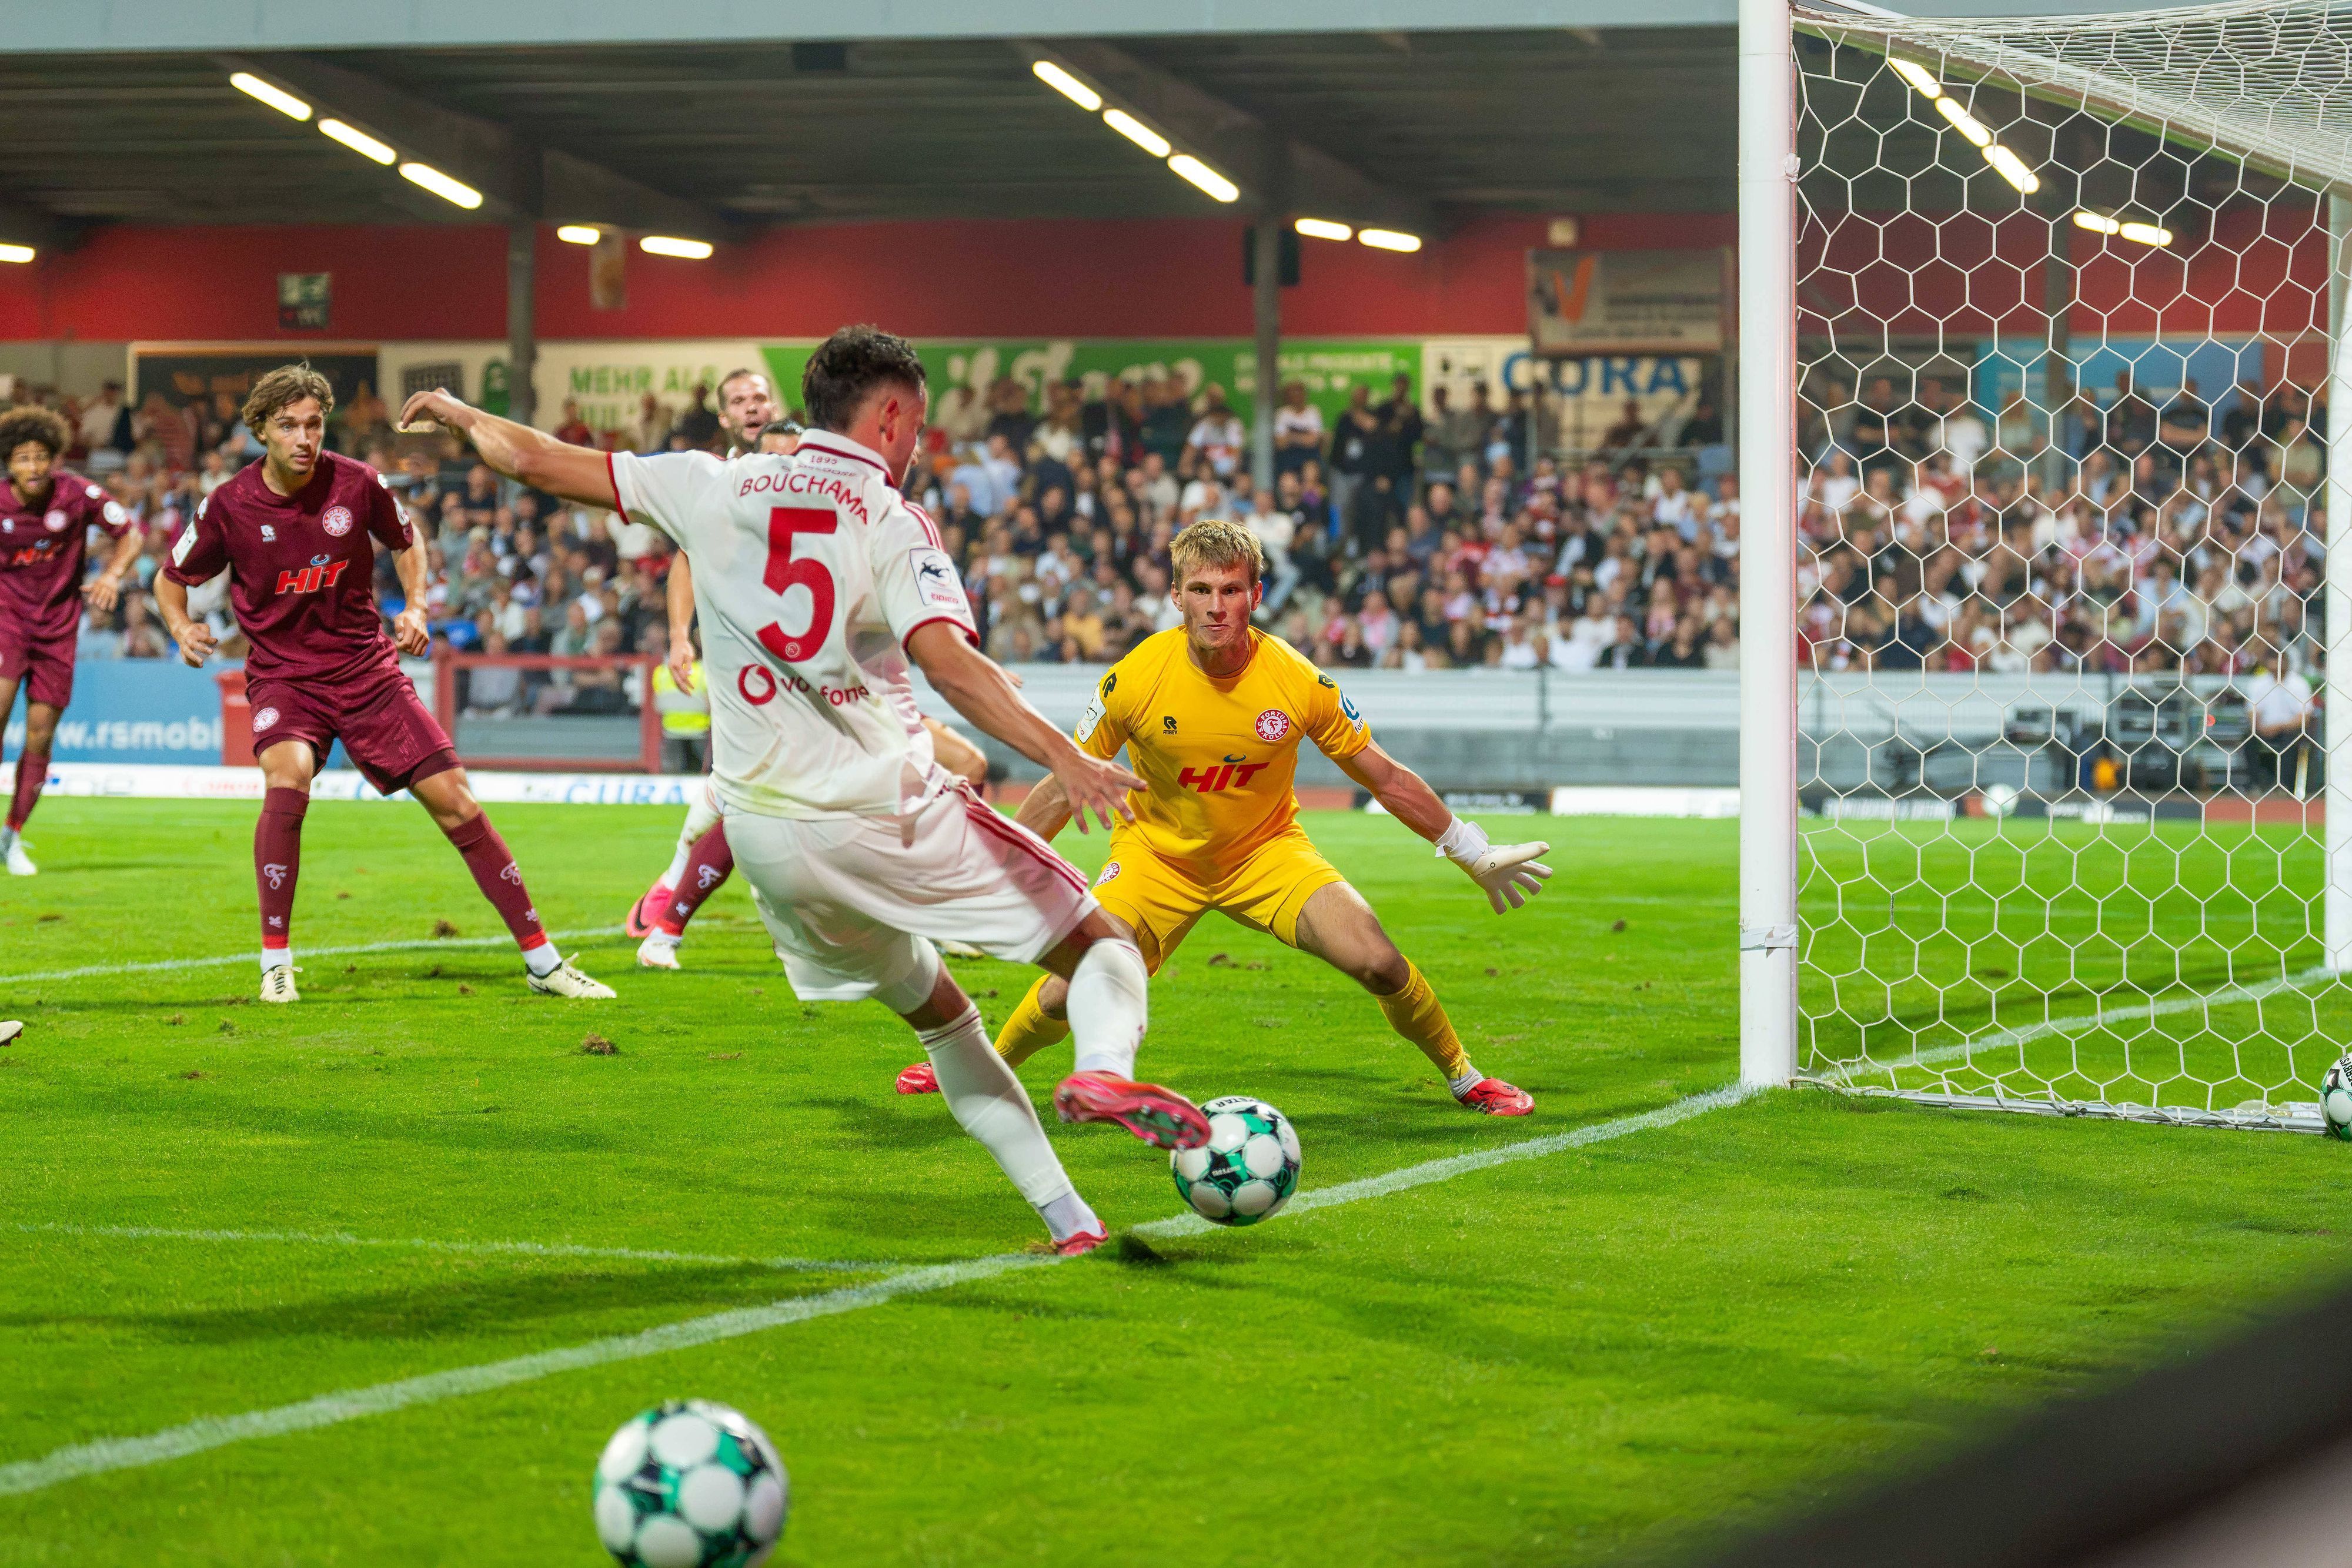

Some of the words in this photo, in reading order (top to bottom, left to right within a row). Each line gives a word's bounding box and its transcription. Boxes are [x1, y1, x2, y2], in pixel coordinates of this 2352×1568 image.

[569, 365, 654, 394] MEHR
[811, 455, 837, 464] 1895
[739, 473, 868, 525] BOUCHAMA
[275, 559, 350, 595] HIT
[757, 506, 838, 663] 5
[1261, 711, 1288, 729] FORTUNA
[1177, 762, 1270, 793] HIT
